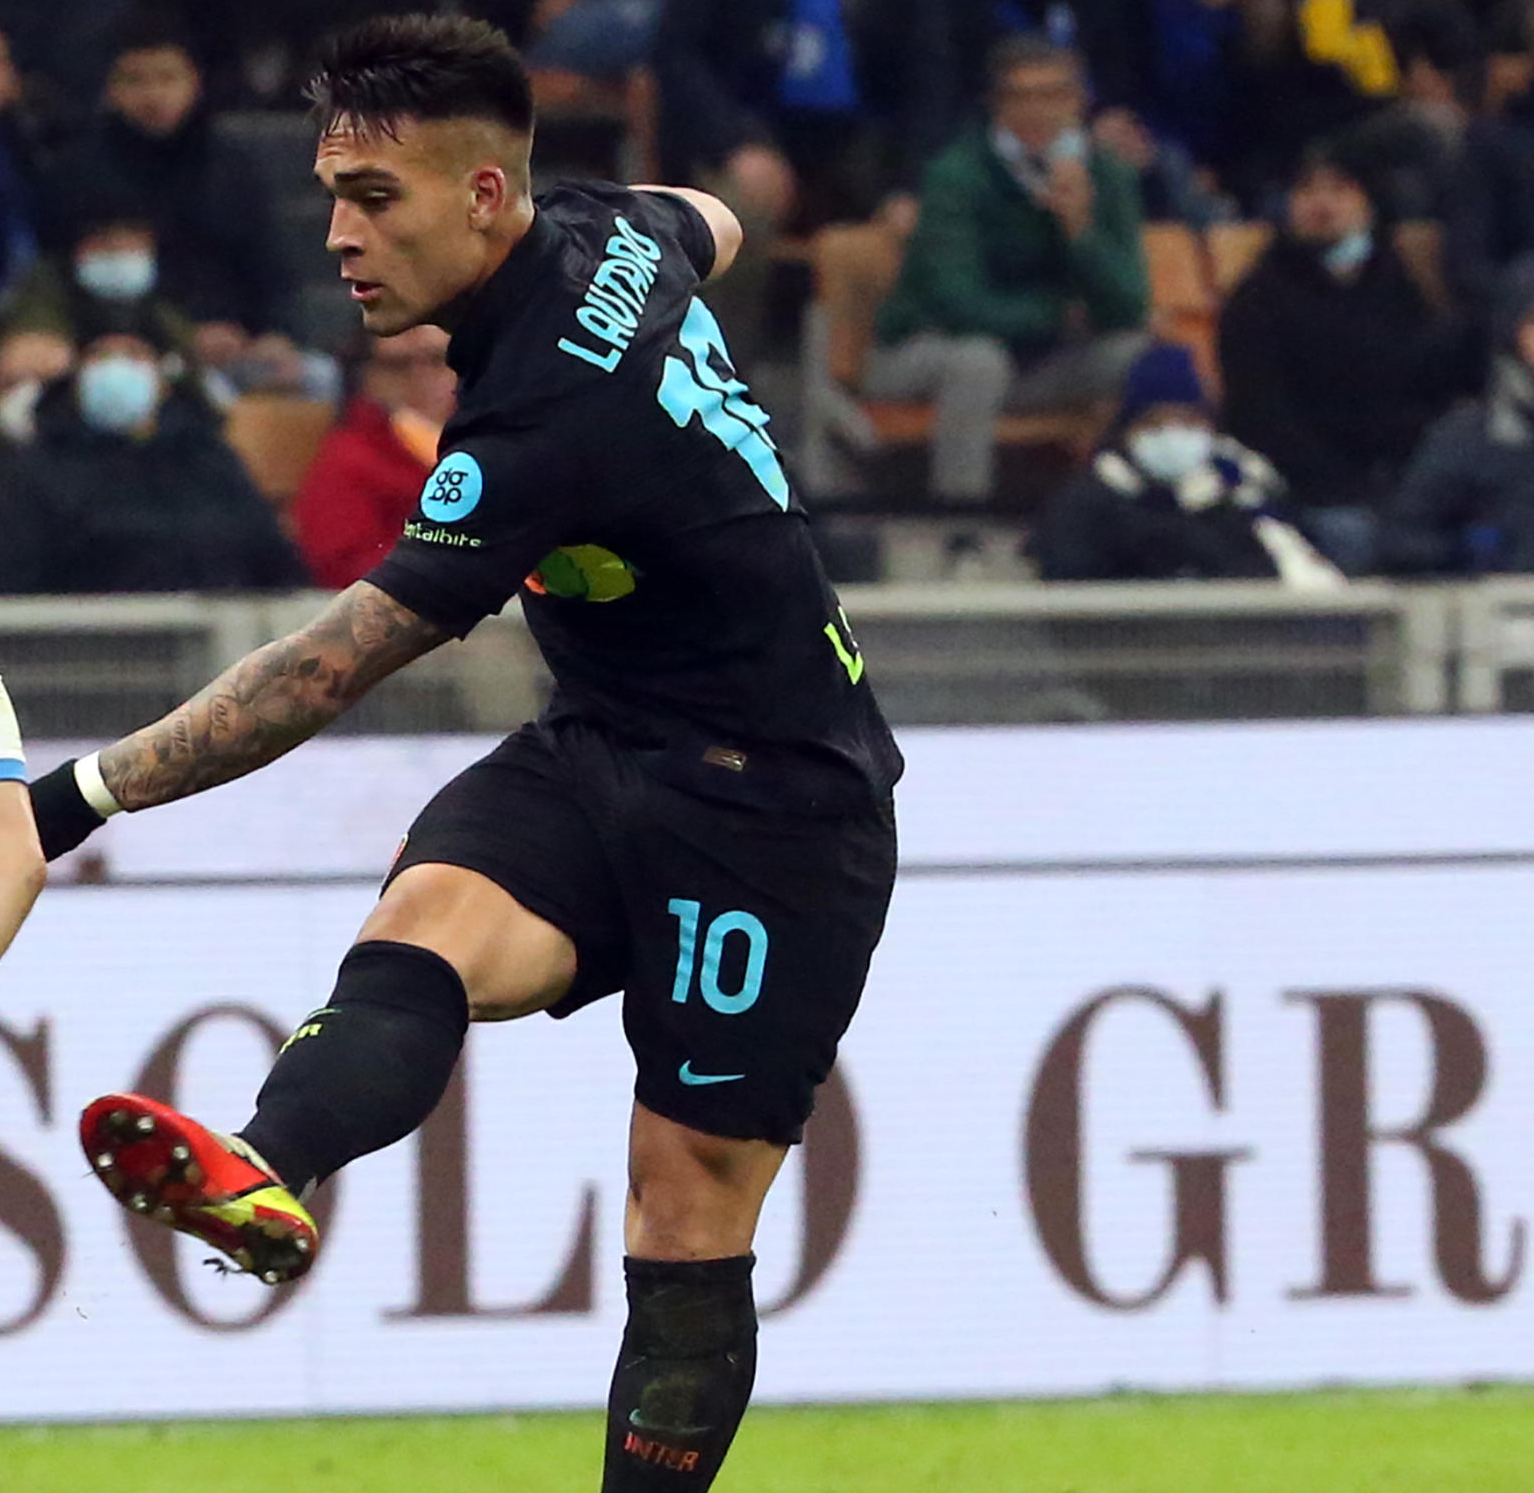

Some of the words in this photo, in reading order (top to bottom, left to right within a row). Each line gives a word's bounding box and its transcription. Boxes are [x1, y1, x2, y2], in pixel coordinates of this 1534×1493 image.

[558, 215, 662, 374] LAUTARO
[668, 898, 769, 1015] 10
[1021, 983, 1528, 1312] GR
